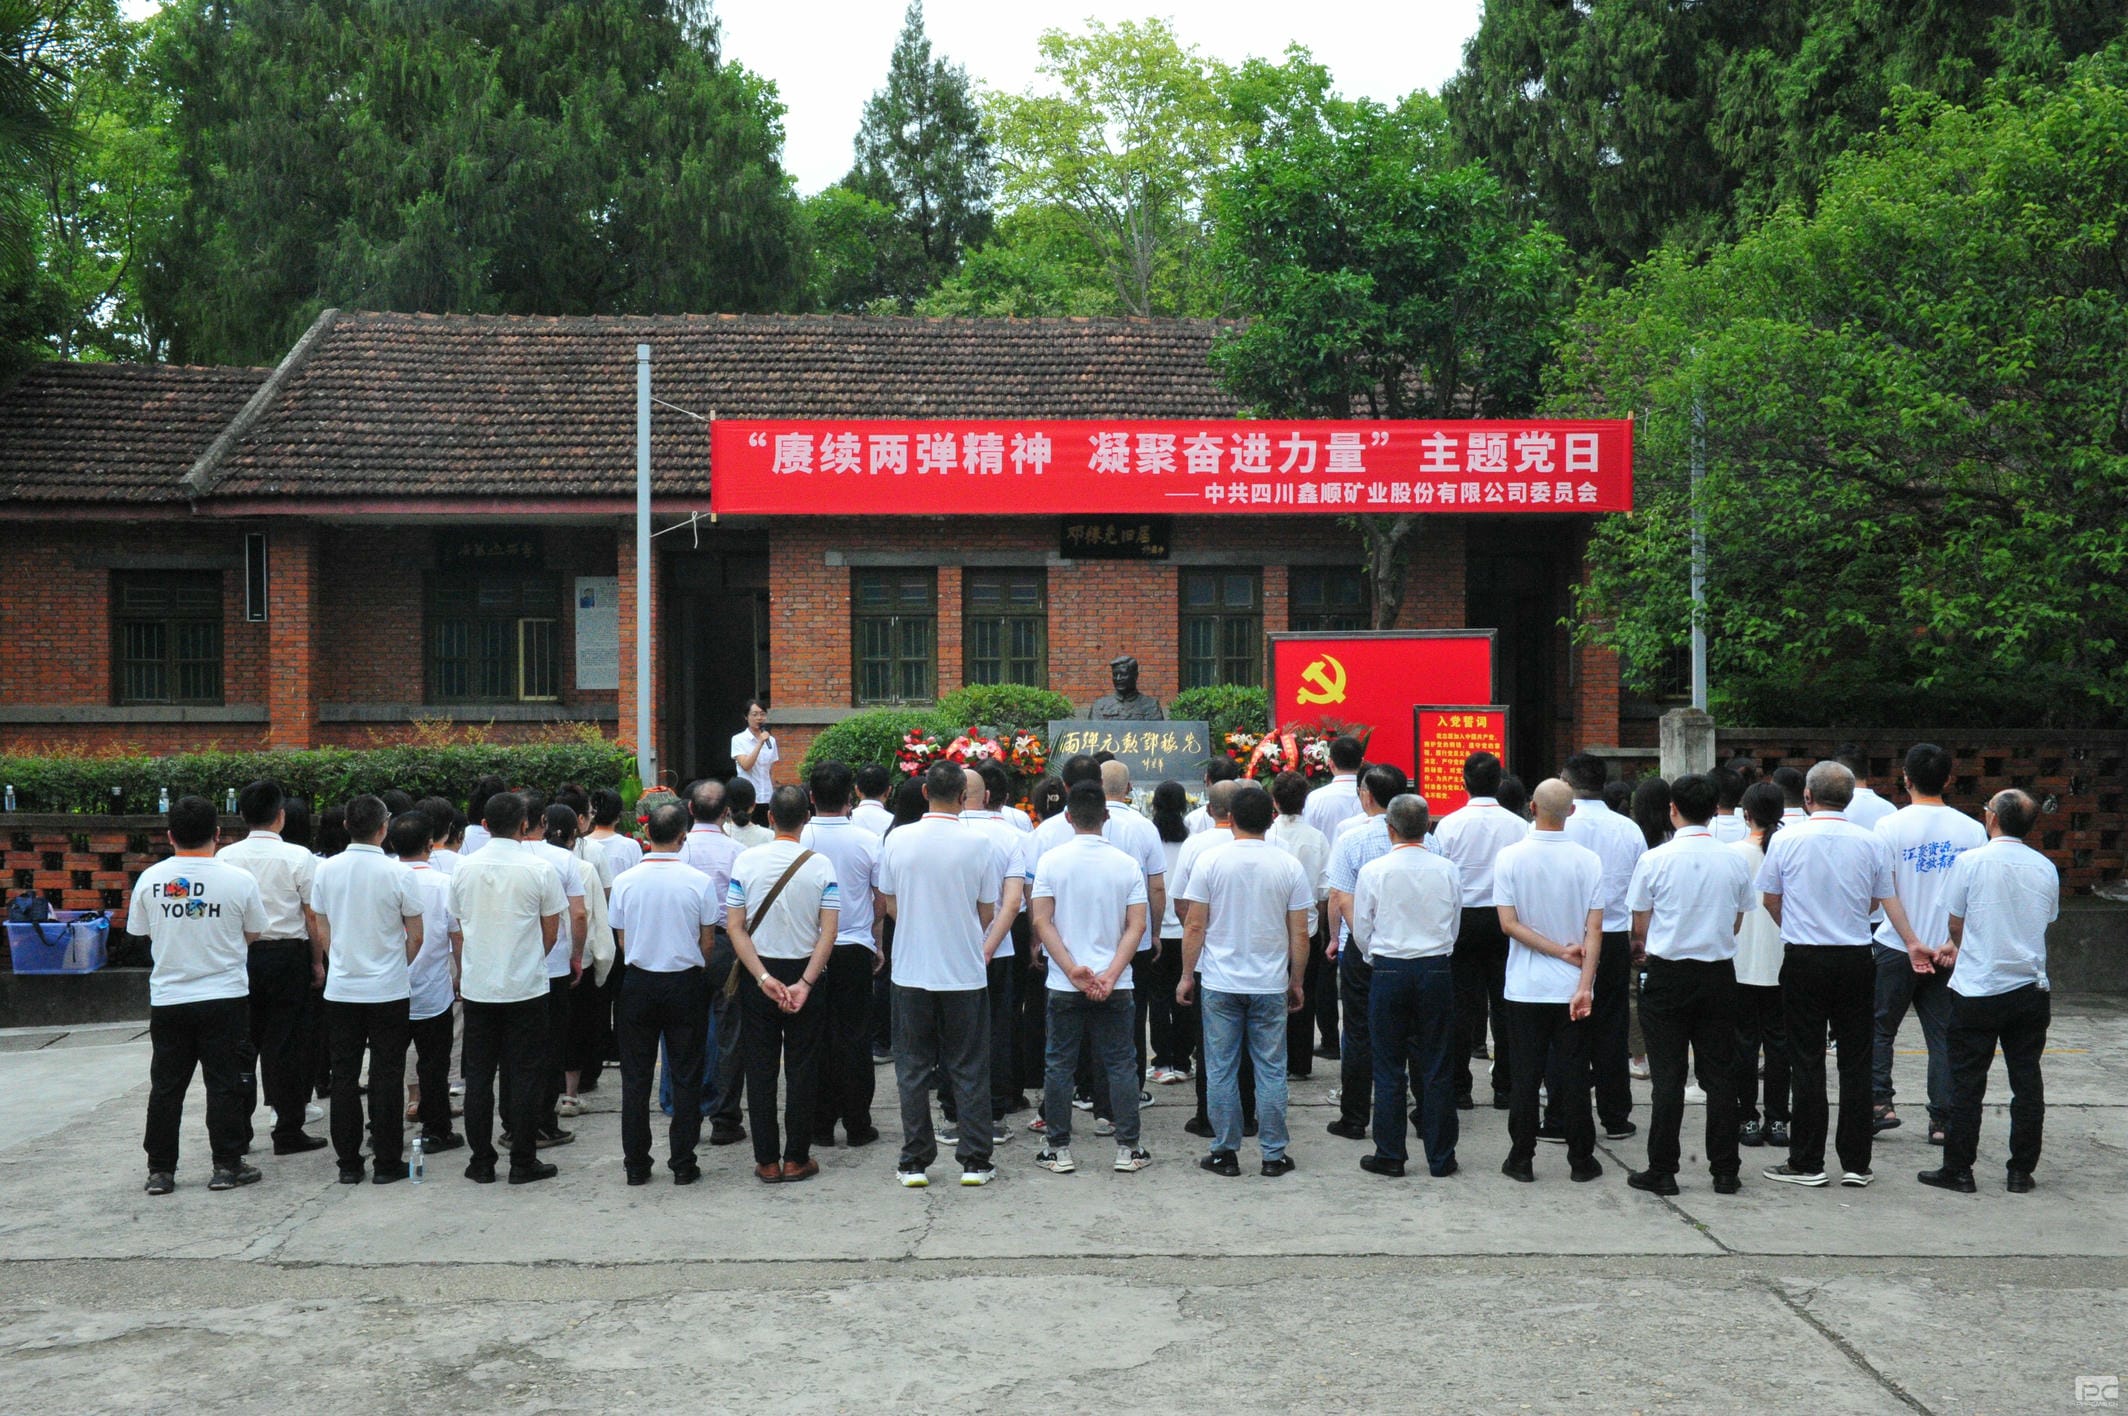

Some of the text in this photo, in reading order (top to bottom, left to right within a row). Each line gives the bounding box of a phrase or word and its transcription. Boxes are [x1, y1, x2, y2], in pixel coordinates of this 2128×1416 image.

[748, 431, 1599, 475] “赓续两弹精神 凝聚奋进力量” 主题党日
[1437, 715, 1487, 728] 入党誓词
[161, 903, 221, 918] YOUTH
